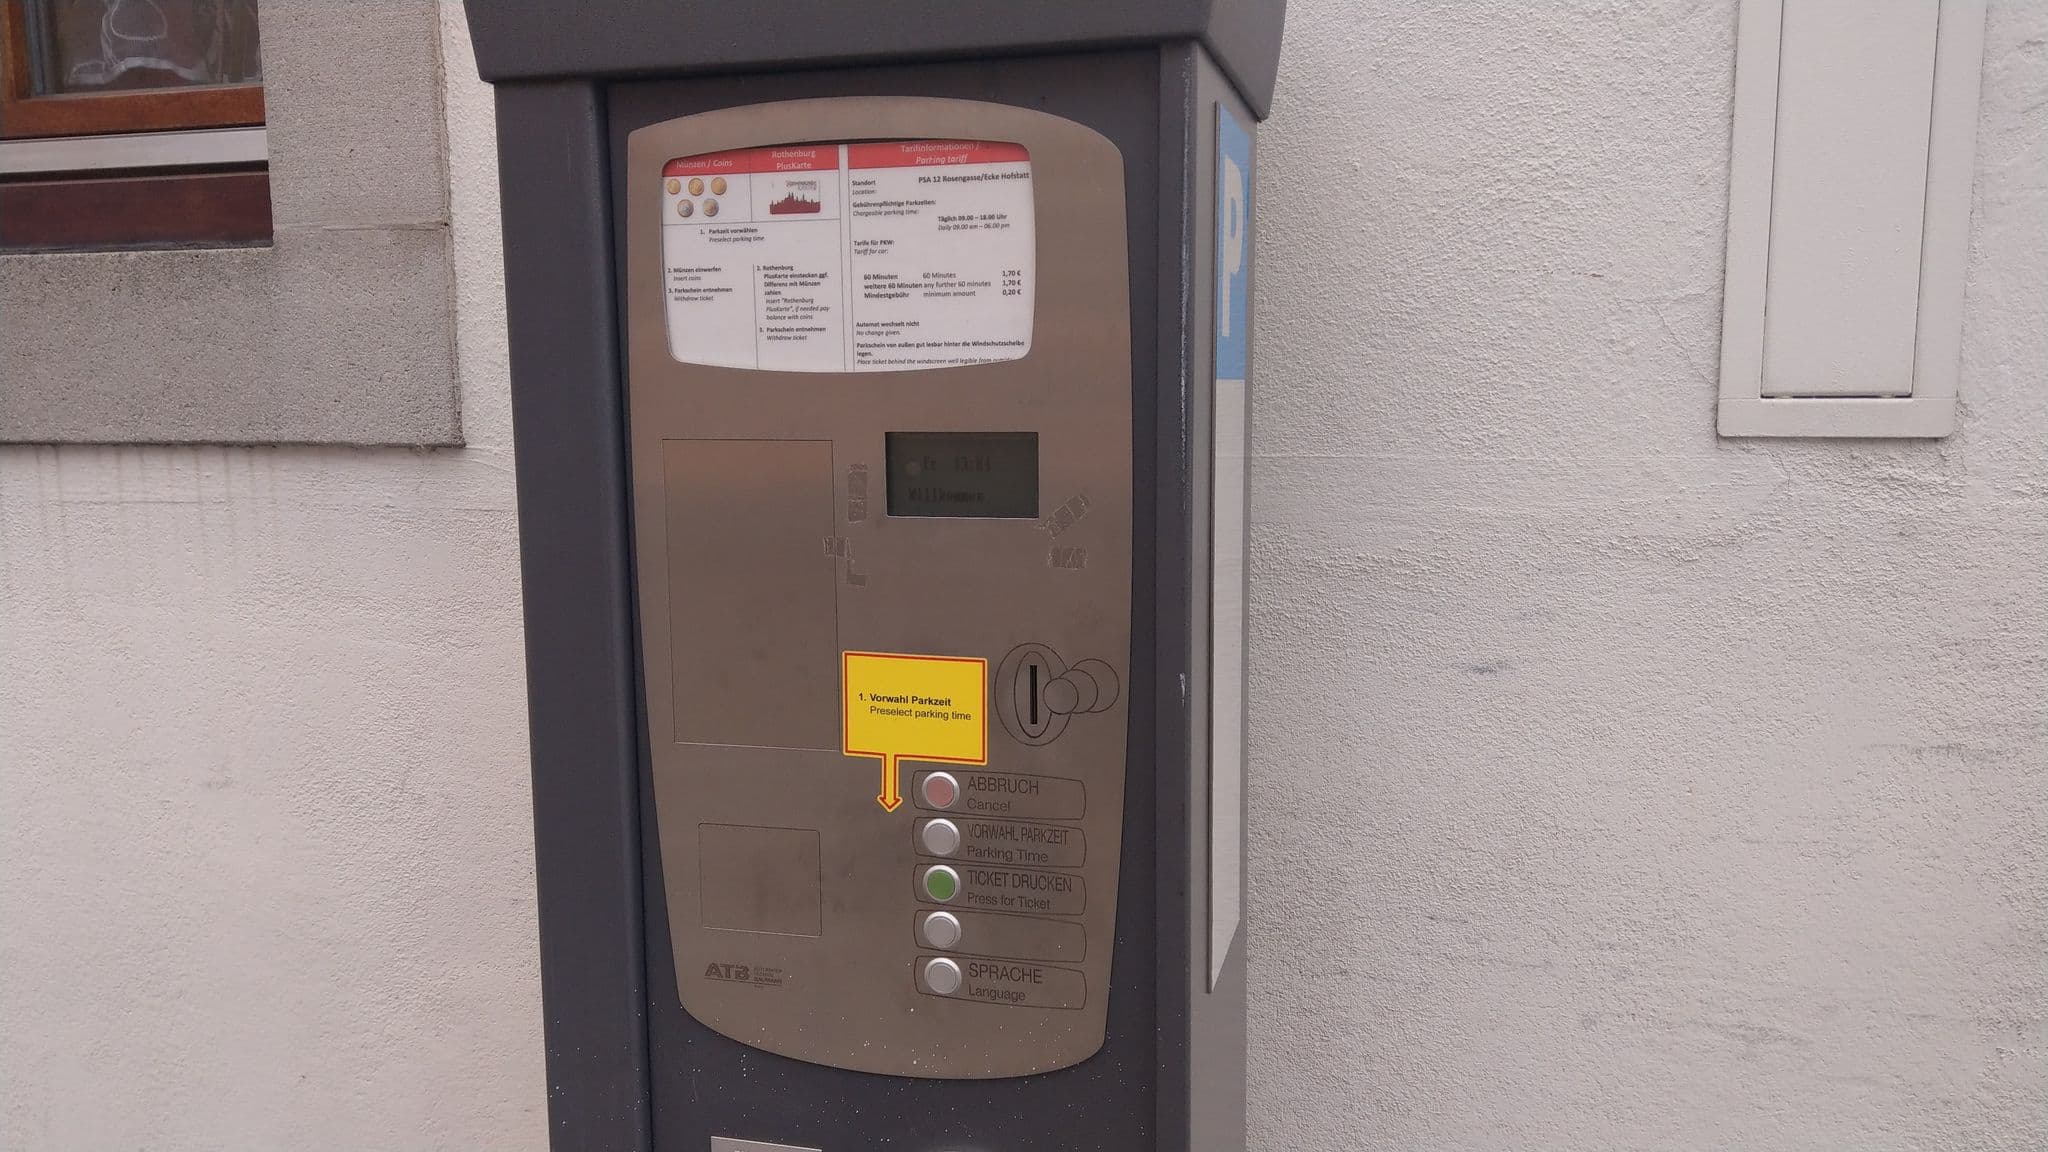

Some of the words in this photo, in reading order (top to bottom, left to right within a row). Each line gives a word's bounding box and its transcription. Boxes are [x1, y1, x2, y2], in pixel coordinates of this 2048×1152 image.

[772, 151, 816, 159] Rothenburg
[901, 144, 974, 153] Tarifinformationen
[713, 159, 733, 167] Coins
[777, 162, 812, 170] PlusKarte
[916, 156, 946, 164] Parking
[948, 154, 968, 163] tariff
[943, 173, 999, 182] Rosengasse/Ecke
[1001, 172, 1029, 180] Hofstatt
[1222, 154, 1244, 336] P
[897, 281, 922, 289] Minuten
[864, 291, 909, 299] Mindestgebühr
[926, 340, 942, 348] lesbar
[869, 693, 909, 704] Vorwahl
[911, 696, 951, 707] Parkzeit
[869, 706, 912, 717] Preselect
[914, 708, 949, 721] parking
[951, 710, 972, 721] time
[967, 776, 1039, 795] ABBRUCH
[967, 798, 1011, 812] Cancel
[968, 824, 1018, 842] VORWAHL
[1021, 827, 1069, 845] PARKZEIT
[968, 846, 1013, 862] Parking
[1017, 849, 1048, 862] Time
[968, 869, 1009, 887] TICKET
[1012, 873, 1072, 892] DRUCKEN
[968, 892, 997, 905] Press
[1001, 895, 1014, 906] for
[1018, 896, 1050, 910] Ticket
[705, 963, 750, 980] ATB
[969, 962, 1043, 984] SPRACHE
[969, 984, 1026, 1002] Language
